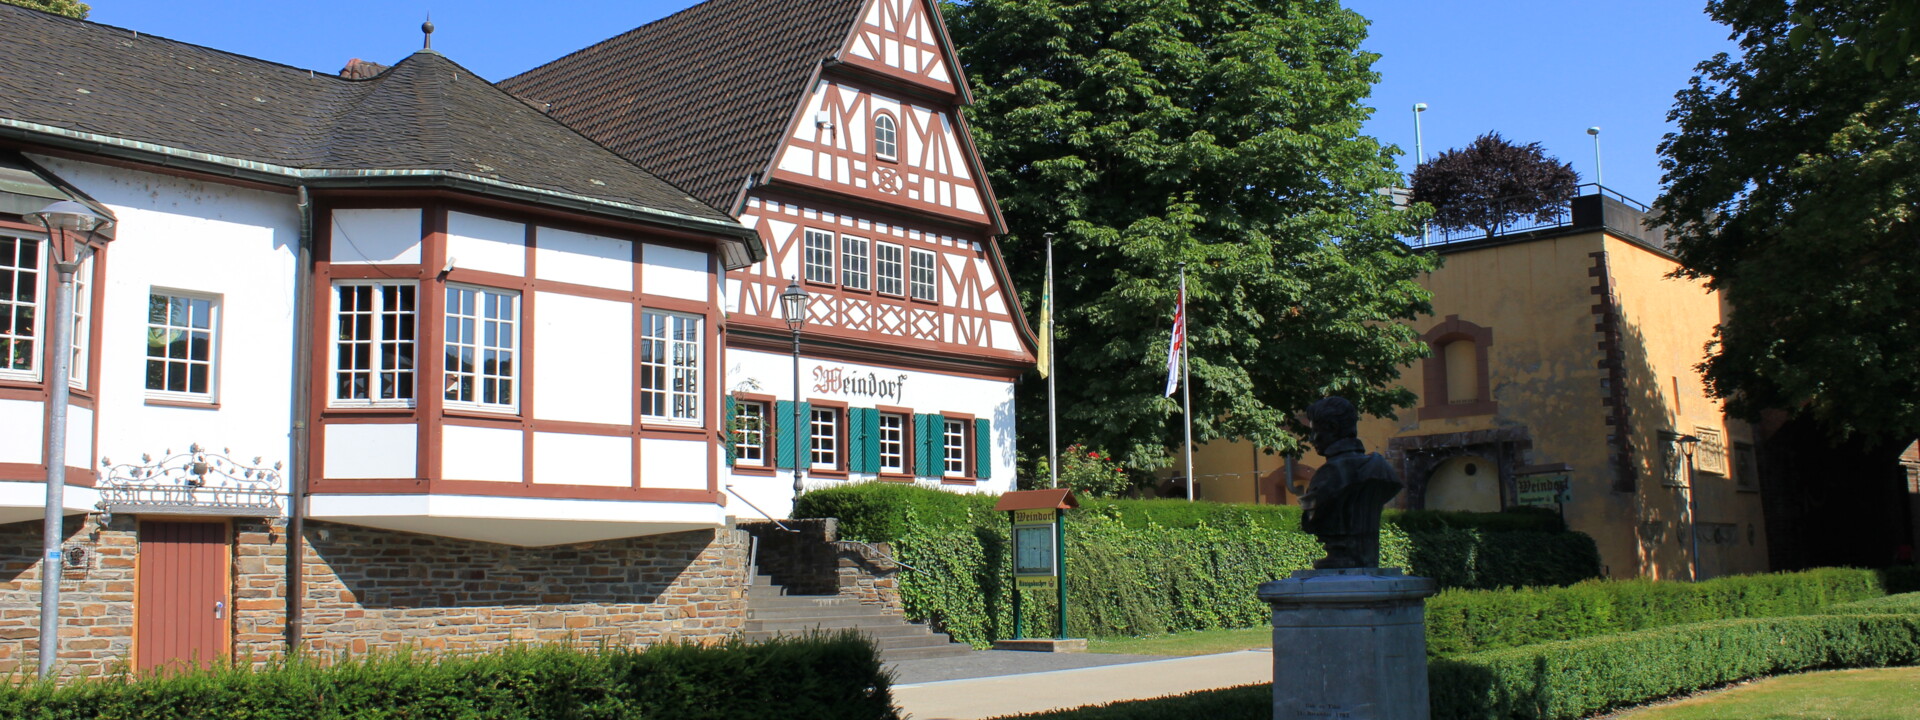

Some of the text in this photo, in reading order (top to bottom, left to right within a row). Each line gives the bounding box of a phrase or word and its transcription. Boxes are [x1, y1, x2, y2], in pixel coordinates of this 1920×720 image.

[812, 365, 907, 405] Weindorf
[114, 485, 281, 509] BACCHUS KELLER
[1016, 510, 1055, 522] Weindorf
